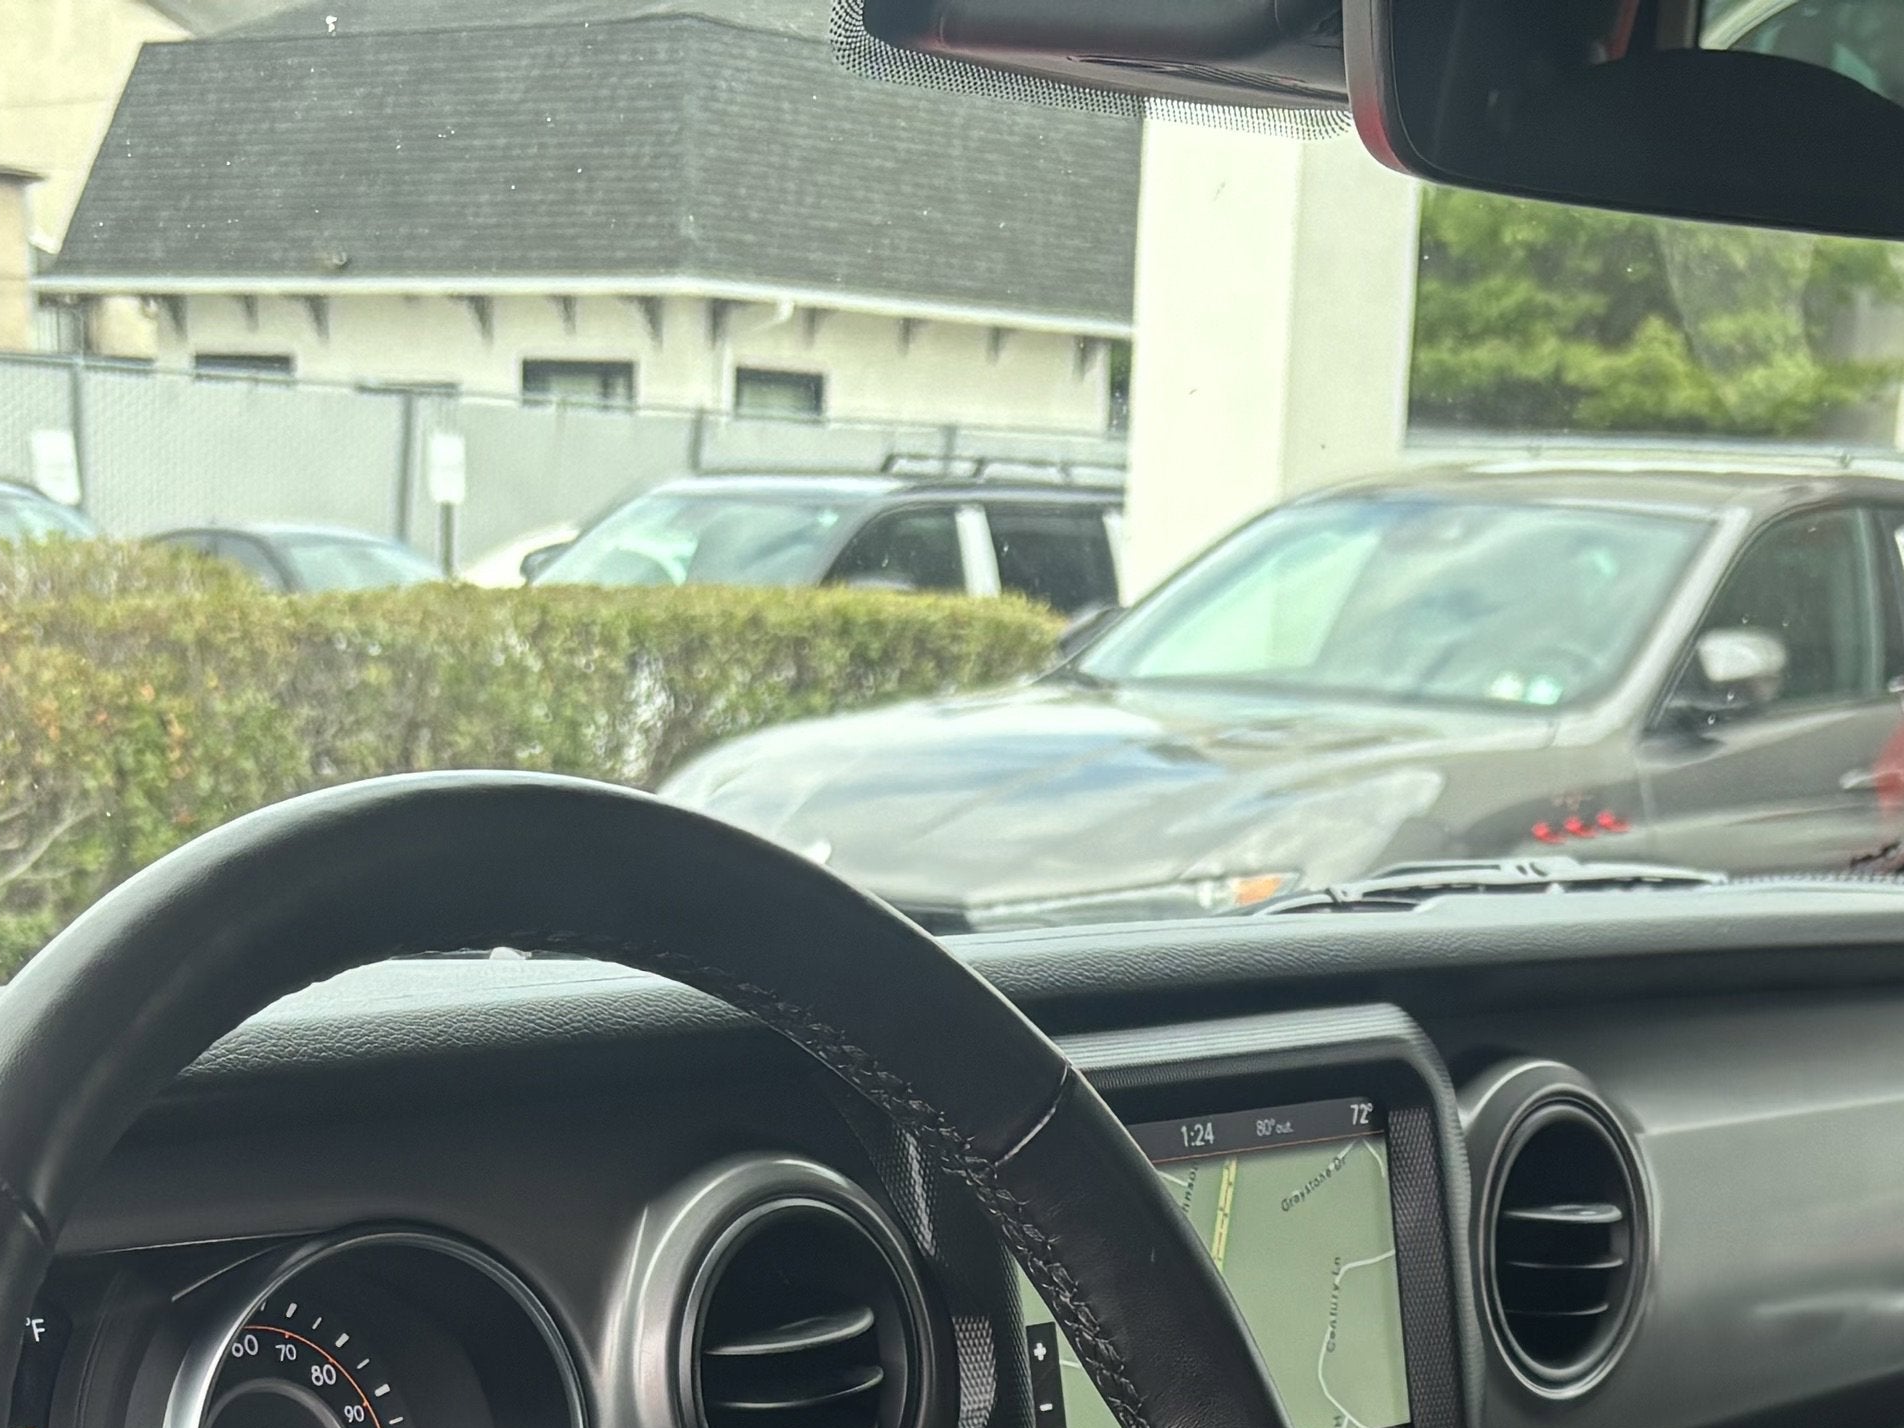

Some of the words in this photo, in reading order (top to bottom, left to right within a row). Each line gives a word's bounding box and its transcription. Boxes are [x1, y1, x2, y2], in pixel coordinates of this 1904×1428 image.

[1181, 1122, 1214, 1147] 1:24
[275, 1344, 297, 1361] 70
[311, 1364, 336, 1386] 80
[344, 1405, 365, 1423] 90
